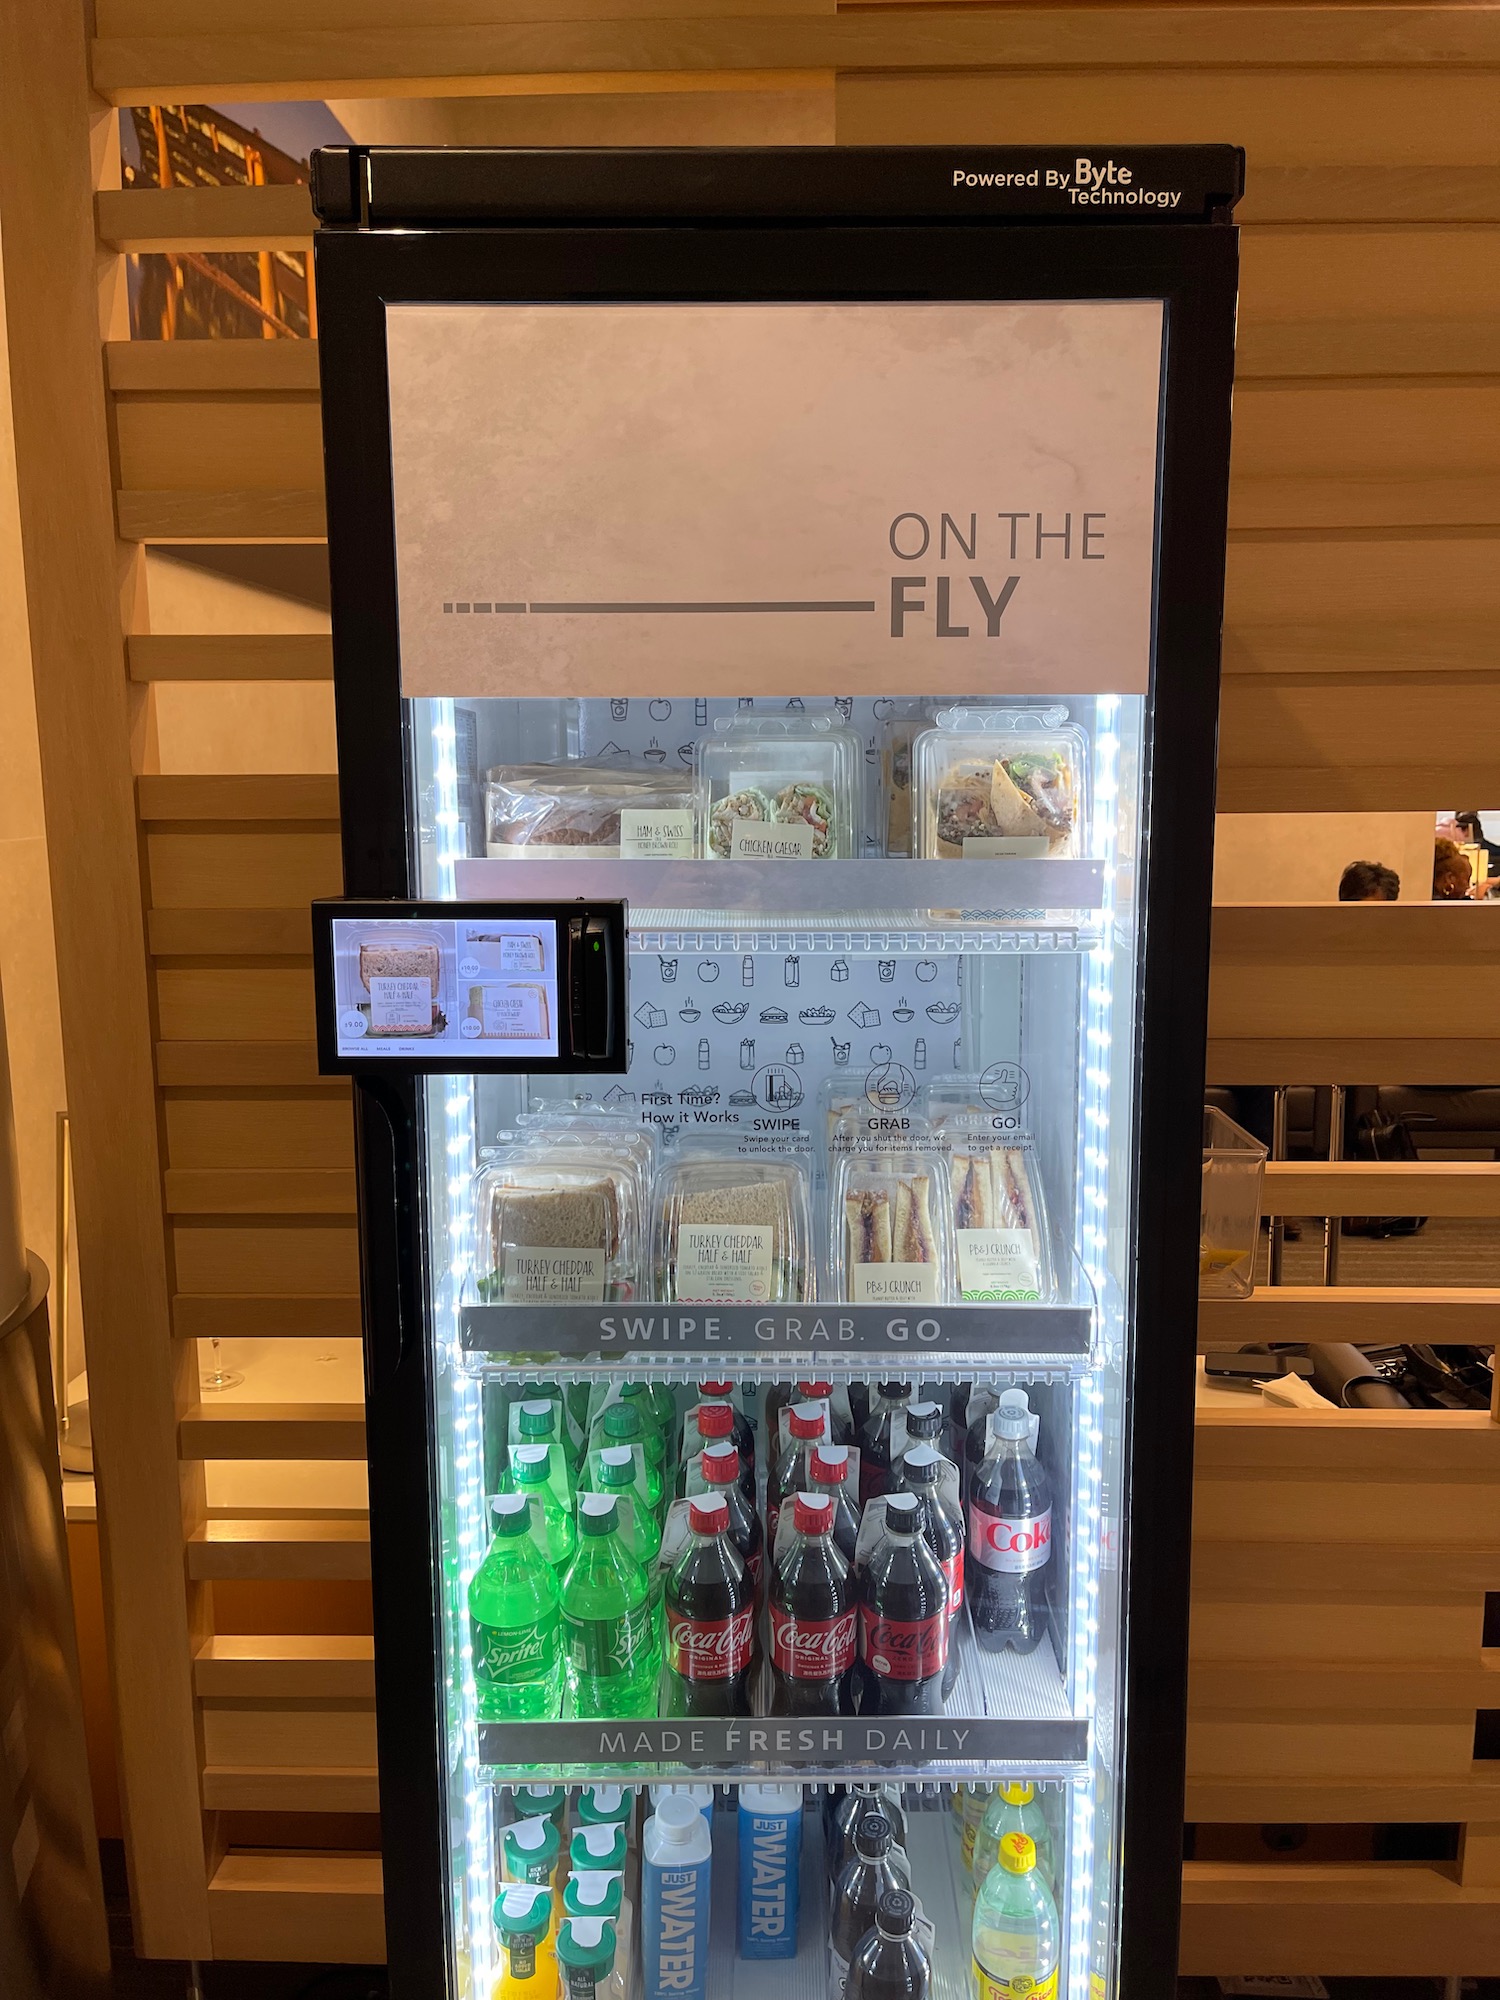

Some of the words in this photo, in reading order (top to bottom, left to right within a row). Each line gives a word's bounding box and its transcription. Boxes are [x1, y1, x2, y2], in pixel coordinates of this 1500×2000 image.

[953, 170, 1039, 187] Powered
[1045, 170, 1070, 189] By
[1075, 158, 1133, 191] Byte
[1068, 188, 1182, 208] Technology
[889, 512, 977, 560] ON
[998, 512, 1106, 559] THE
[890, 576, 1021, 637] FLY
[636, 825, 652, 838] HAM
[655, 826, 661, 836] &
[663, 825, 684, 837] SWISS
[739, 839, 773, 854] CHICKEN
[774, 841, 802, 856] CAESAR
[378, 982, 397, 991] TURKEY
[384, 991, 395, 1000] HALF
[402, 991, 414, 999] HALF
[641, 1093, 673, 1105] First
[677, 1092, 721, 1105] Time?
[642, 1111, 675, 1124] How
[679, 1111, 689, 1123] it
[693, 1110, 740, 1123] Works
[867, 1117, 911, 1130] GRAB
[992, 1117, 1022, 1129] GO!
[752, 1118, 800, 1131] SWIPE
[743, 1135, 769, 1144] Swipe
[771, 1136, 789, 1144] your
[791, 1134, 810, 1142] card
[832, 1134, 854, 1143] After
[856, 1135, 872, 1143] you
[873, 1134, 891, 1142] shut
[893, 1134, 907, 1142] the
[909, 1134, 931, 1143] door,
[967, 1133, 990, 1141] Enter
[992, 1135, 1011, 1143] your
[1013, 1133, 1036, 1141] email
[749, 1145, 777, 1153] unlock
[778, 1145, 792, 1153] the
[793, 1145, 816, 1153] door.
[828, 1145, 856, 1154] charge
[876, 1144, 888, 1152] for
[890, 1144, 909, 1152] items
[910, 1144, 955, 1152] removed.
[978, 1144, 993, 1153] get
[1003, 1144, 1035, 1153] receipt.
[689, 1234, 722, 1248] TURKEY
[723, 1235, 763, 1249] CHEDDAR
[698, 1249, 719, 1263] HALF
[721, 1250, 728, 1261] &
[731, 1249, 752, 1263] HALF
[969, 1243, 989, 1256] PB&J
[990, 1243, 1021, 1255] CRUNCH
[516, 1258, 551, 1275] TURKEY
[552, 1259, 595, 1276] CHEDDAR
[526, 1276, 548, 1291] HALF
[550, 1278, 558, 1290] &
[561, 1276, 583, 1292] HALF
[866, 1280, 888, 1294] PB&J
[889, 1280, 922, 1293] CRUNCH
[600, 1317, 732, 1341] SWIPE.
[754, 1317, 865, 1341] GRAB.
[886, 1318, 950, 1341] GO.
[497, 1628, 532, 1637] LEMON-LIME
[488, 1641, 540, 1667] Sprite
[600, 1731, 705, 1753] MADE
[726, 1729, 843, 1752] FRESH
[866, 1729, 970, 1751] DAILY
[756, 1821, 784, 1831] JUST
[664, 1873, 693, 1884] JUST
[751, 1831, 787, 1937] WATER
[659, 1882, 697, 1990] WATER
[520, 1947, 526, 1955] C
[570, 1980, 594, 1988] NATURAL
